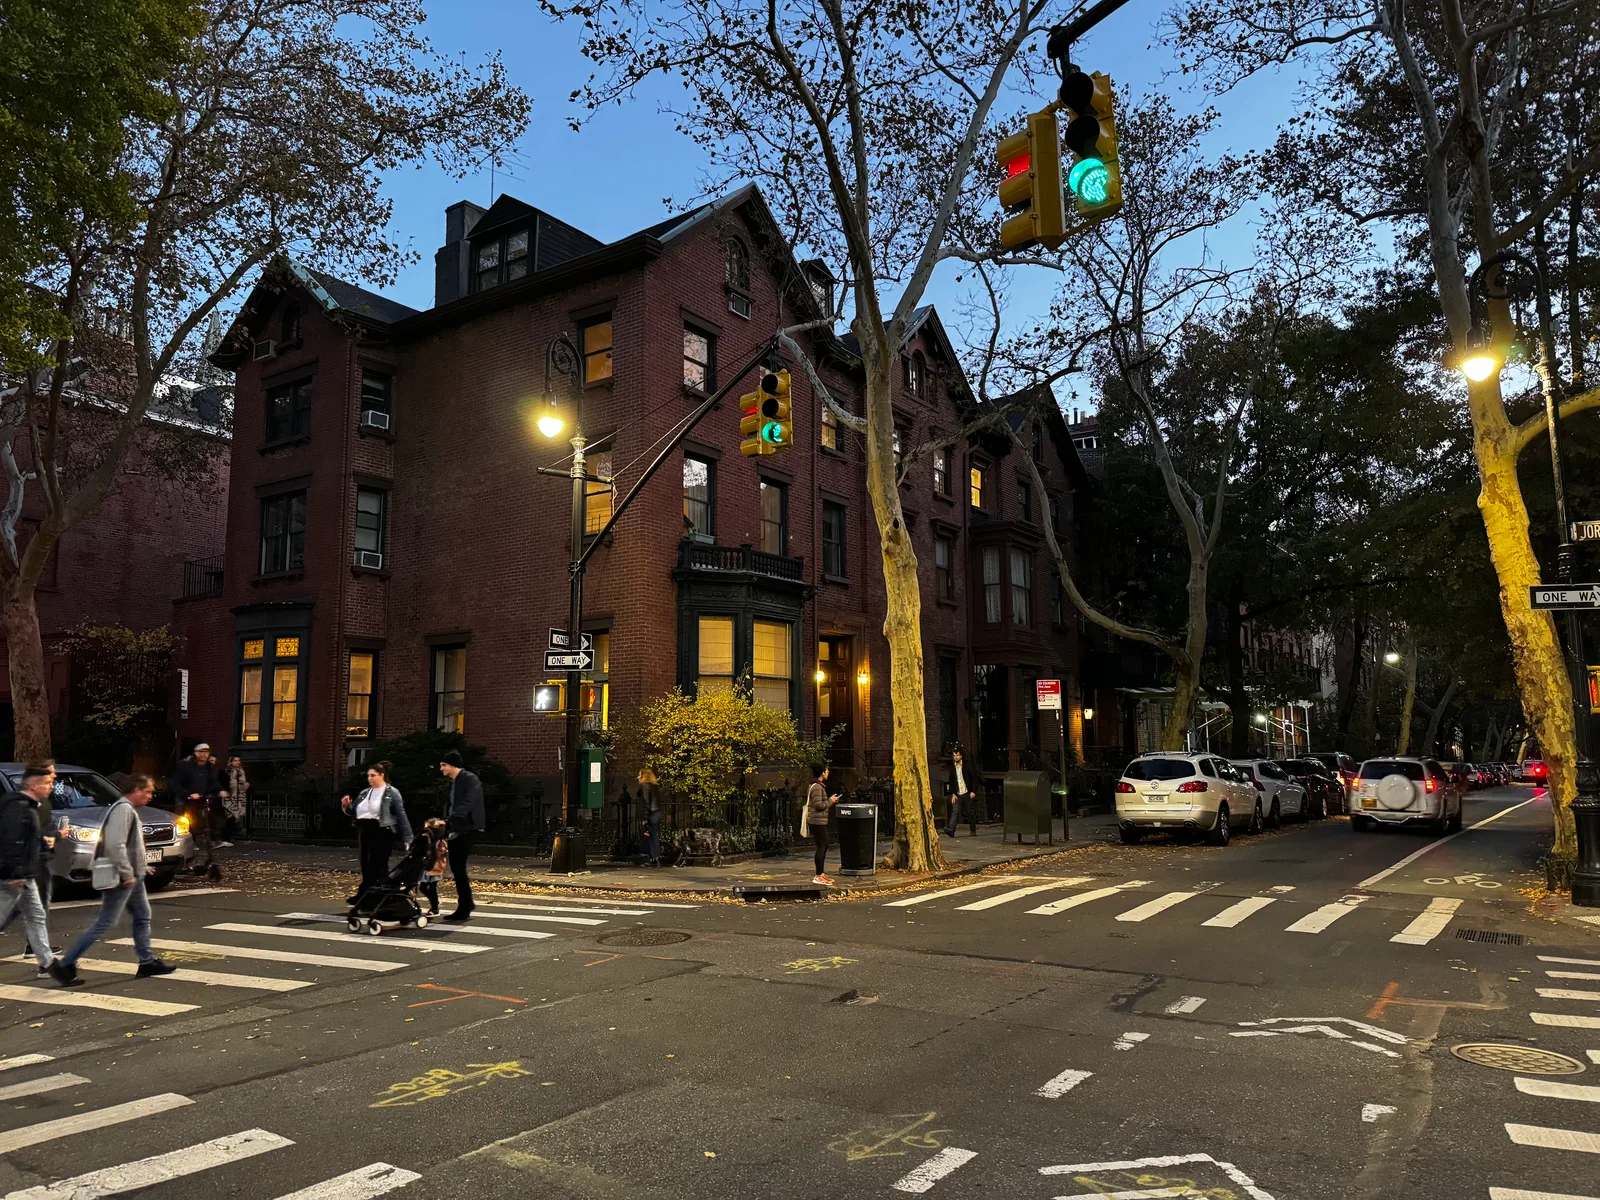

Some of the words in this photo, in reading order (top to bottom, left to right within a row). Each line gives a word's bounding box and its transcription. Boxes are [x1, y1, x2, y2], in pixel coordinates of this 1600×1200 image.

[1580, 524, 1600, 539] JOR
[1542, 592, 1567, 602] ONE
[556, 635, 569, 645] ONE
[551, 656, 566, 665] ONE
[571, 656, 586, 665] WAY
